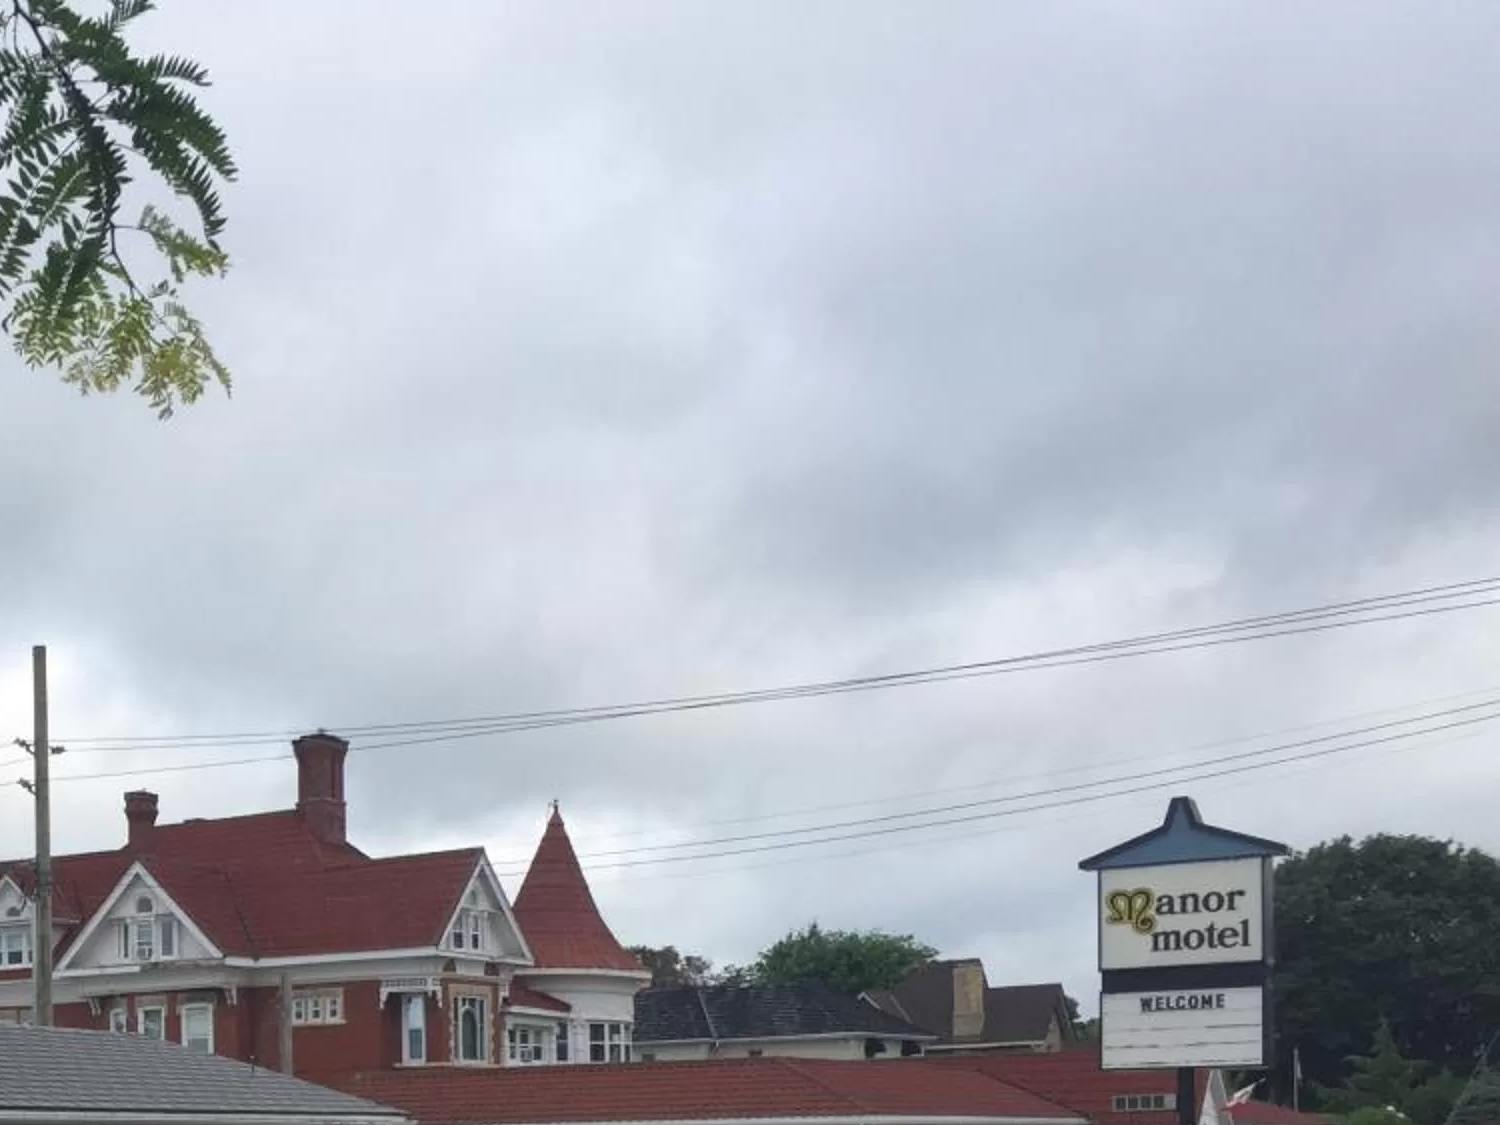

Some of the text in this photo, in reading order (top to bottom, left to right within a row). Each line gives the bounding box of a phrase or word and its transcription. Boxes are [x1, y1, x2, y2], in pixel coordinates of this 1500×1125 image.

[1105, 888, 1246, 935] Manor
[1150, 919, 1252, 952] motel
[1140, 994, 1226, 1012] WELCOME
